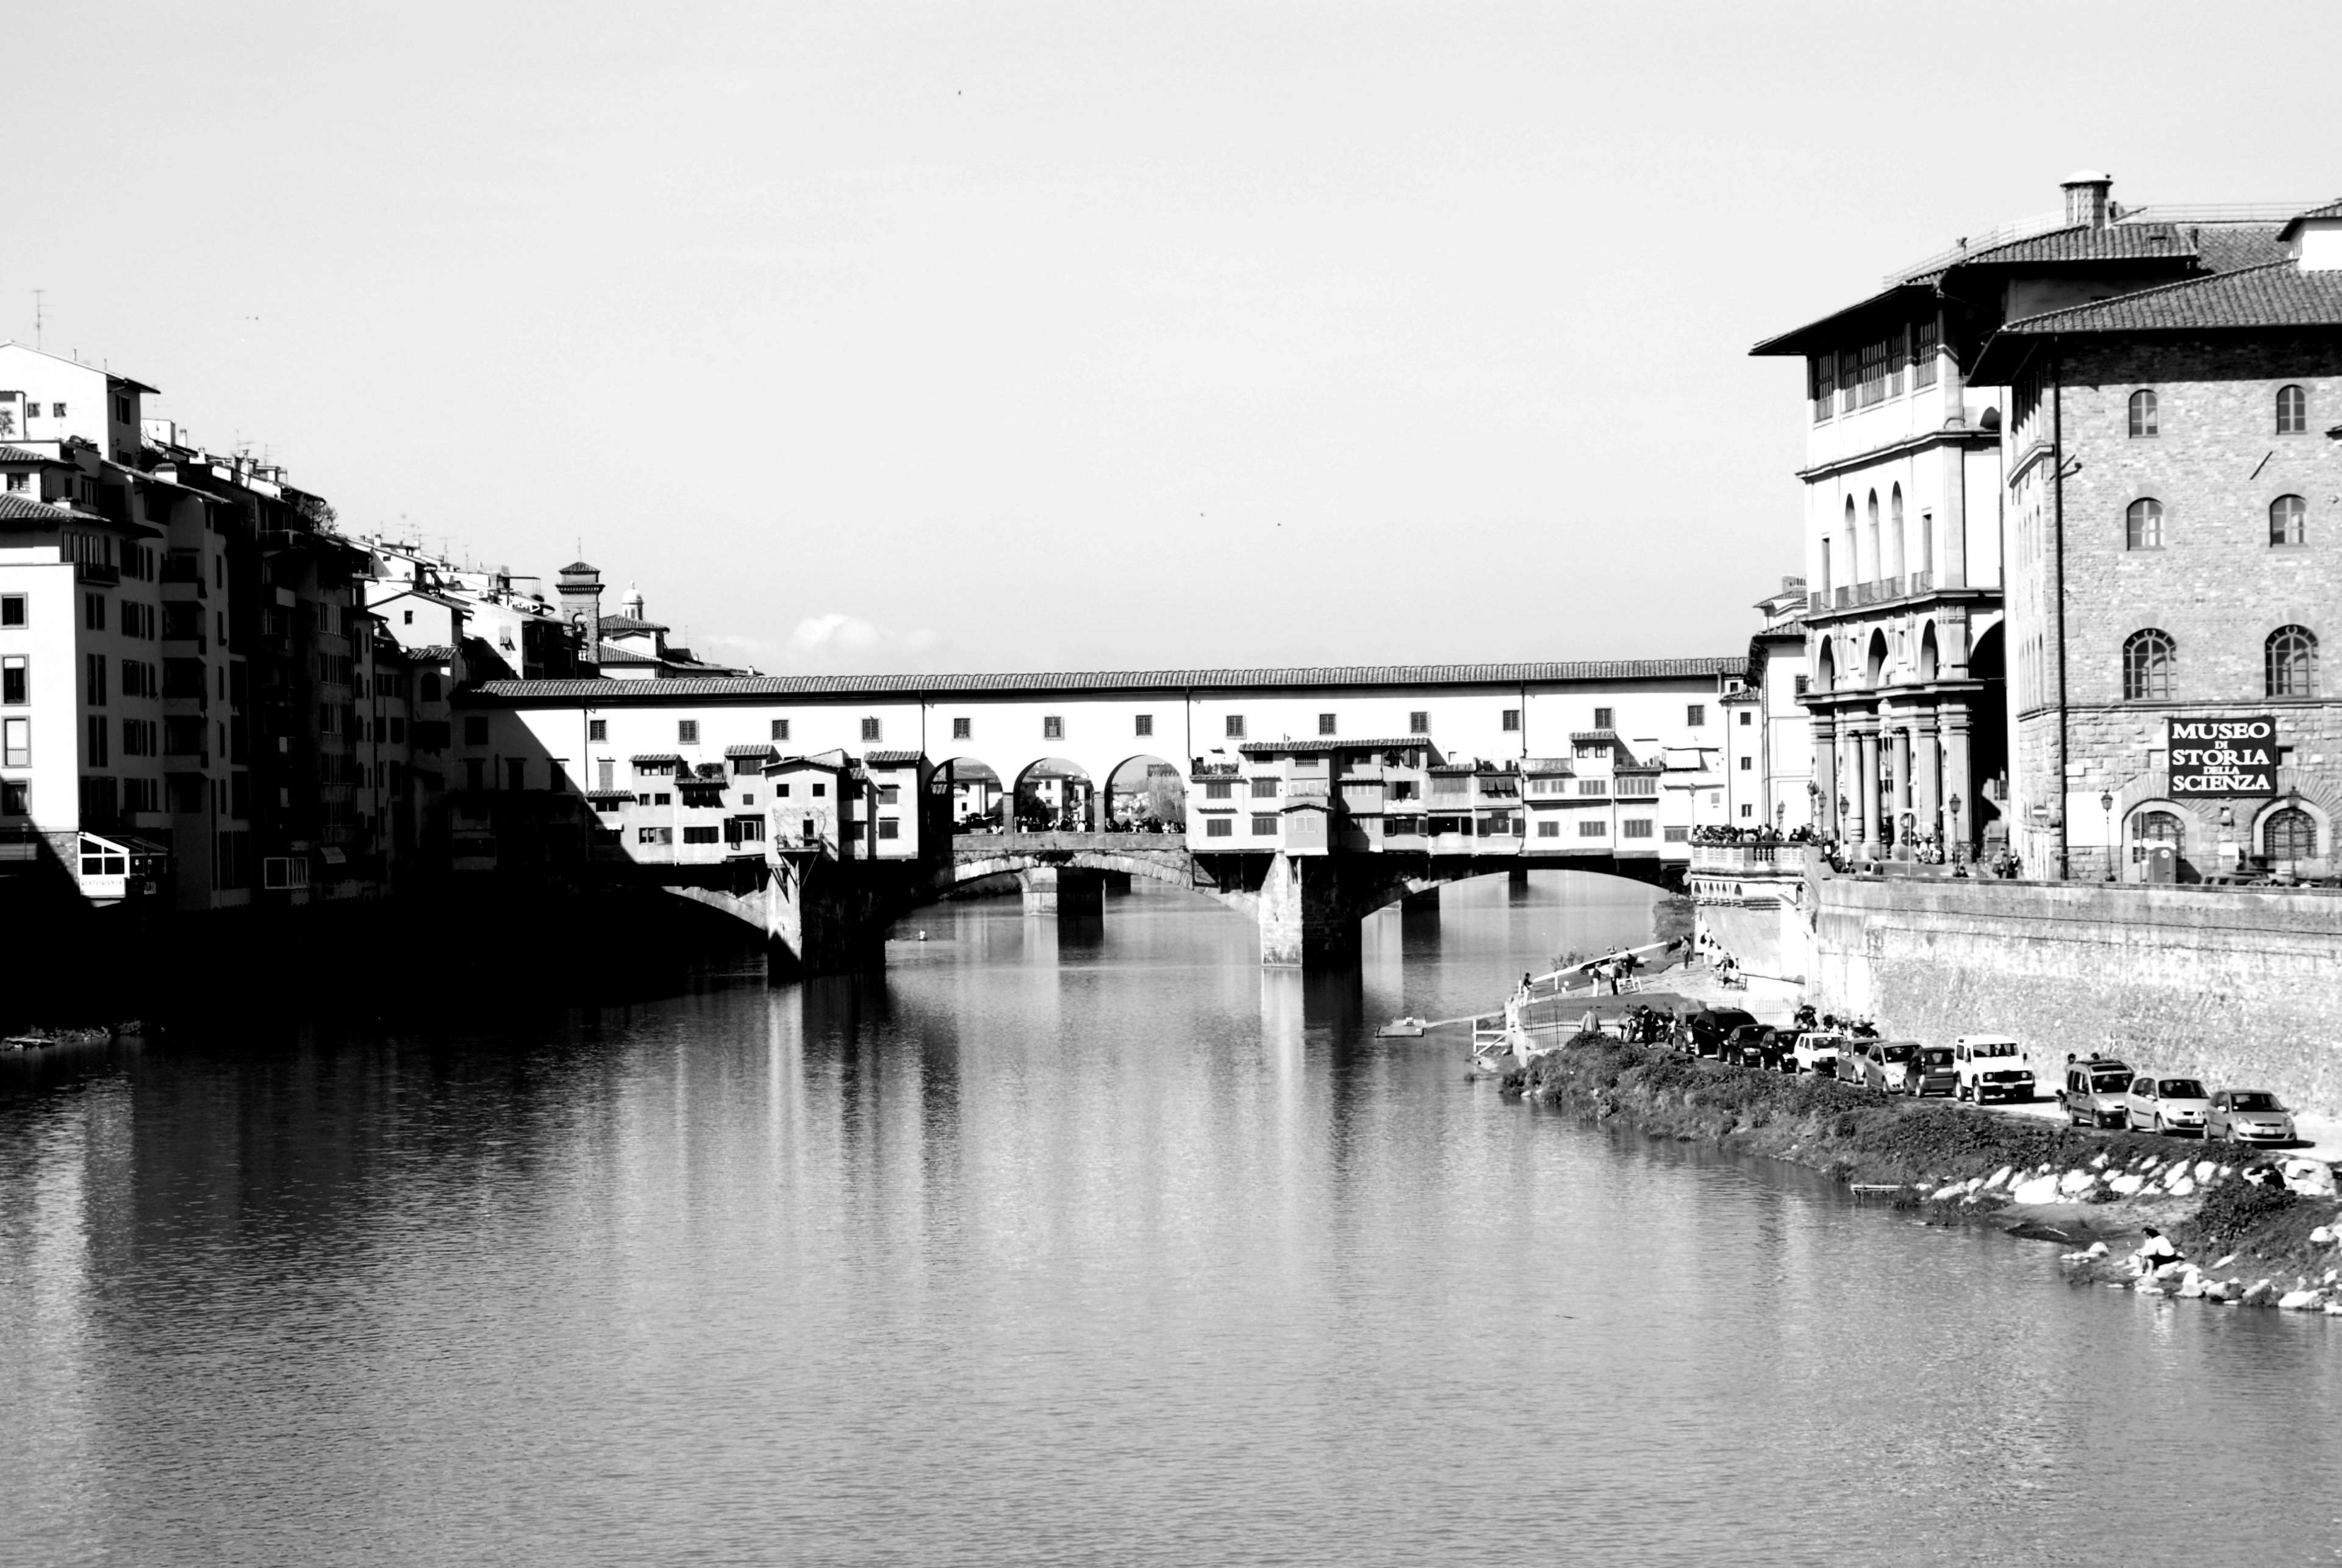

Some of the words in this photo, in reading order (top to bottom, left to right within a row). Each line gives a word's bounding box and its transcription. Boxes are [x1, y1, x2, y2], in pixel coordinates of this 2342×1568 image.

[2172, 722, 2271, 739] MUSEO
[2215, 740, 2229, 750] DI
[2172, 749, 2271, 765] STORIA
[2203, 766, 2240, 775] DELLA
[2172, 774, 2271, 792] SCIENZA
